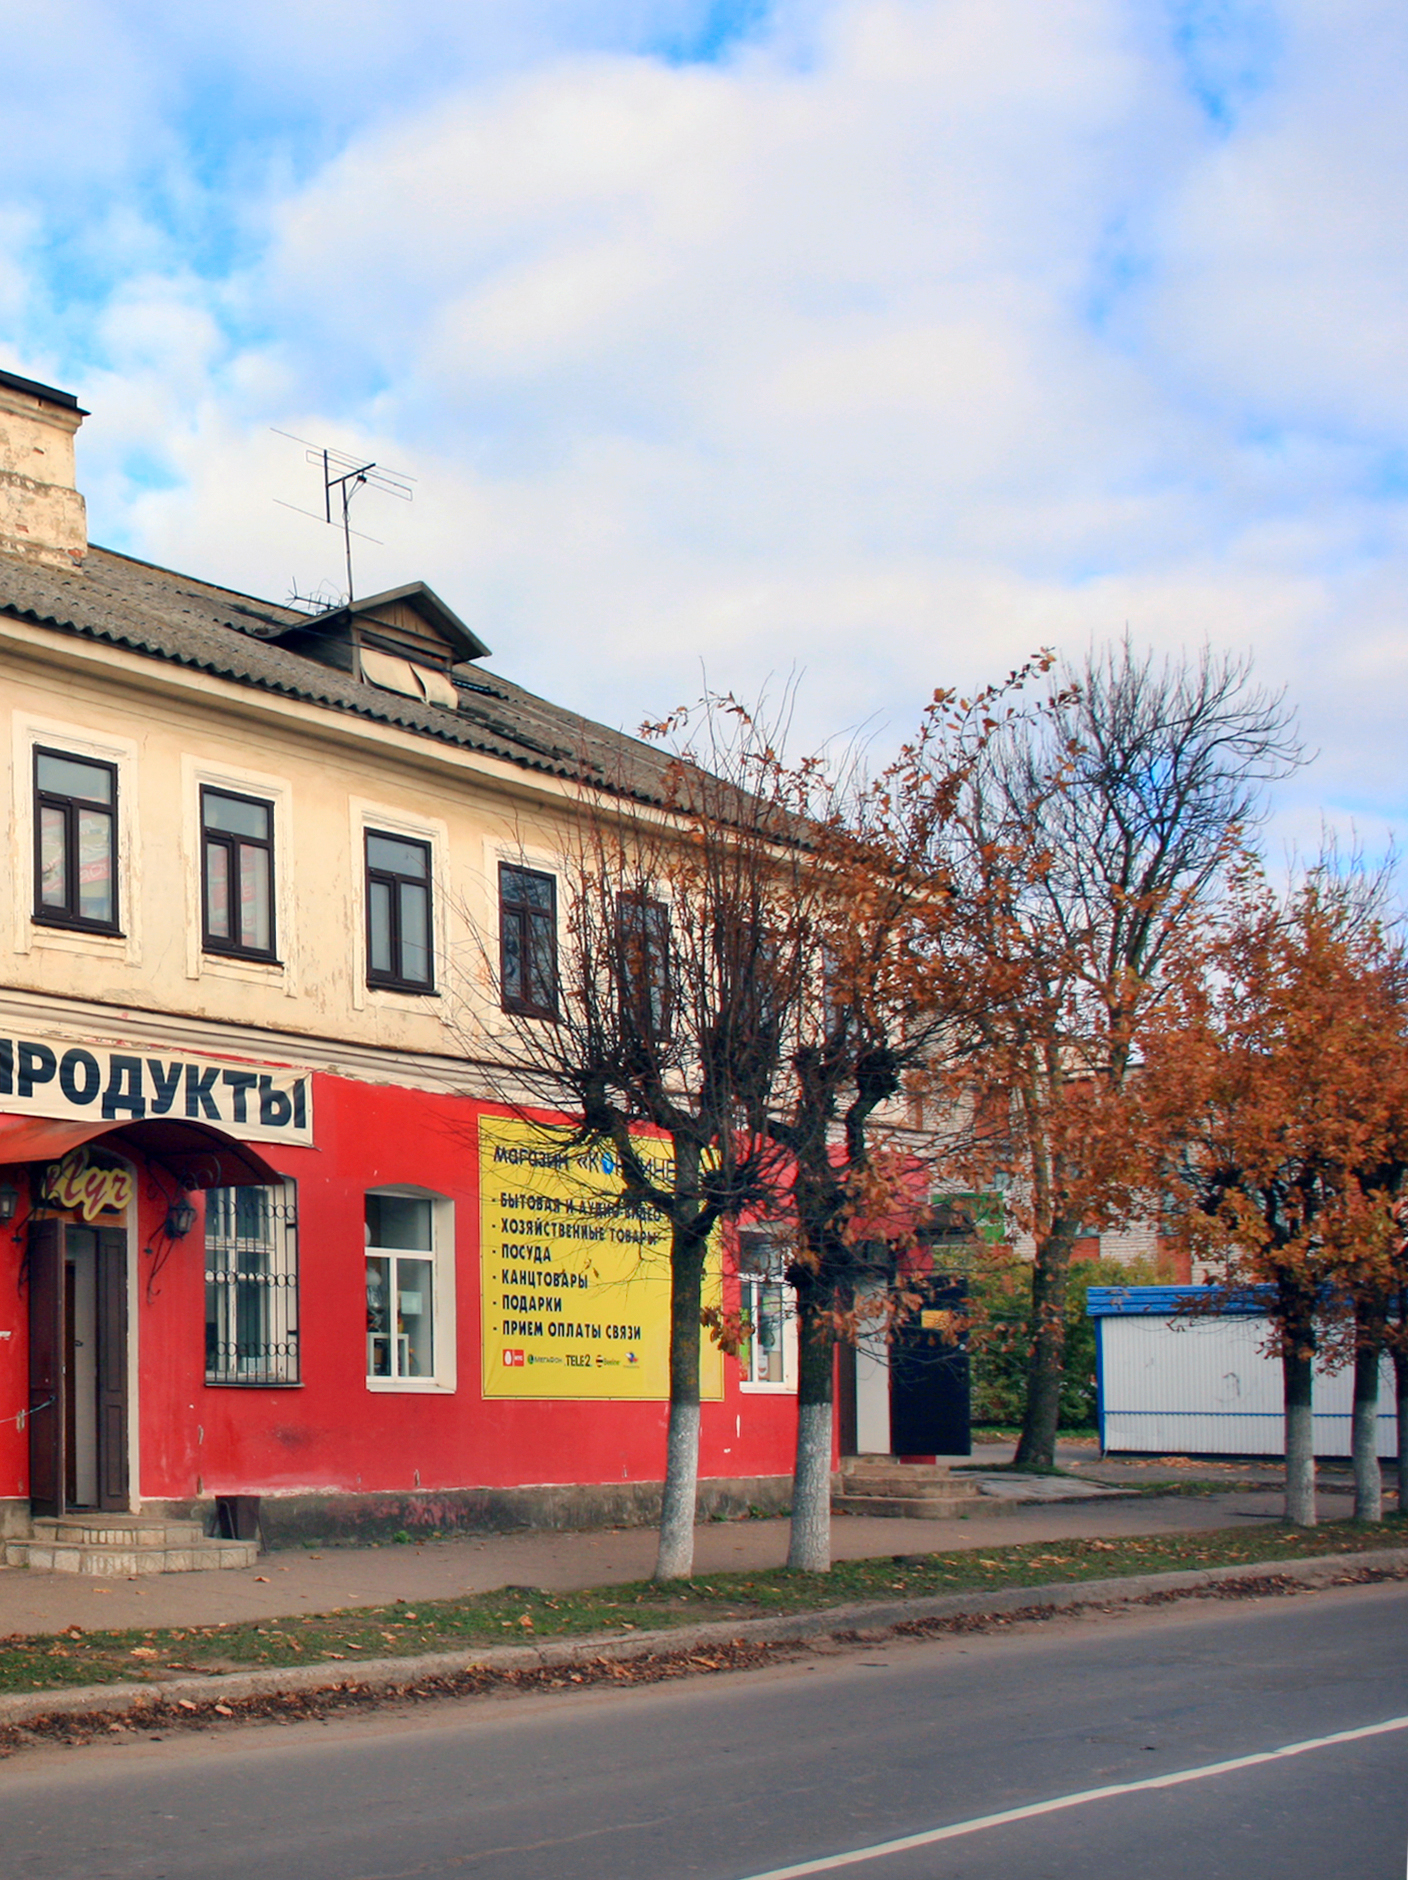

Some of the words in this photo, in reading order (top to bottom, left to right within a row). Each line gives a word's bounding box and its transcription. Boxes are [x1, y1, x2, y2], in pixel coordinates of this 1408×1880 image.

[500, 1192, 560, 1213] БЫТОВАЯ
[566, 1200, 573, 1213] И
[500, 1217, 605, 1241] ХОЗЯЙСТВЕННЫЕ
[609, 1227, 659, 1245] ТОВАРЫ
[501, 1243, 551, 1263] ПОСУДА
[501, 1269, 588, 1288] КАНЦТОВАРЫ
[502, 1294, 562, 1313] ПОДАРКИ
[502, 1319, 542, 1336] ПРИЕМ
[548, 1322, 601, 1338] ОПЛАТЫ
[605, 1325, 641, 1340] СВЯЗИ
[565, 1354, 591, 1367] TELE2
